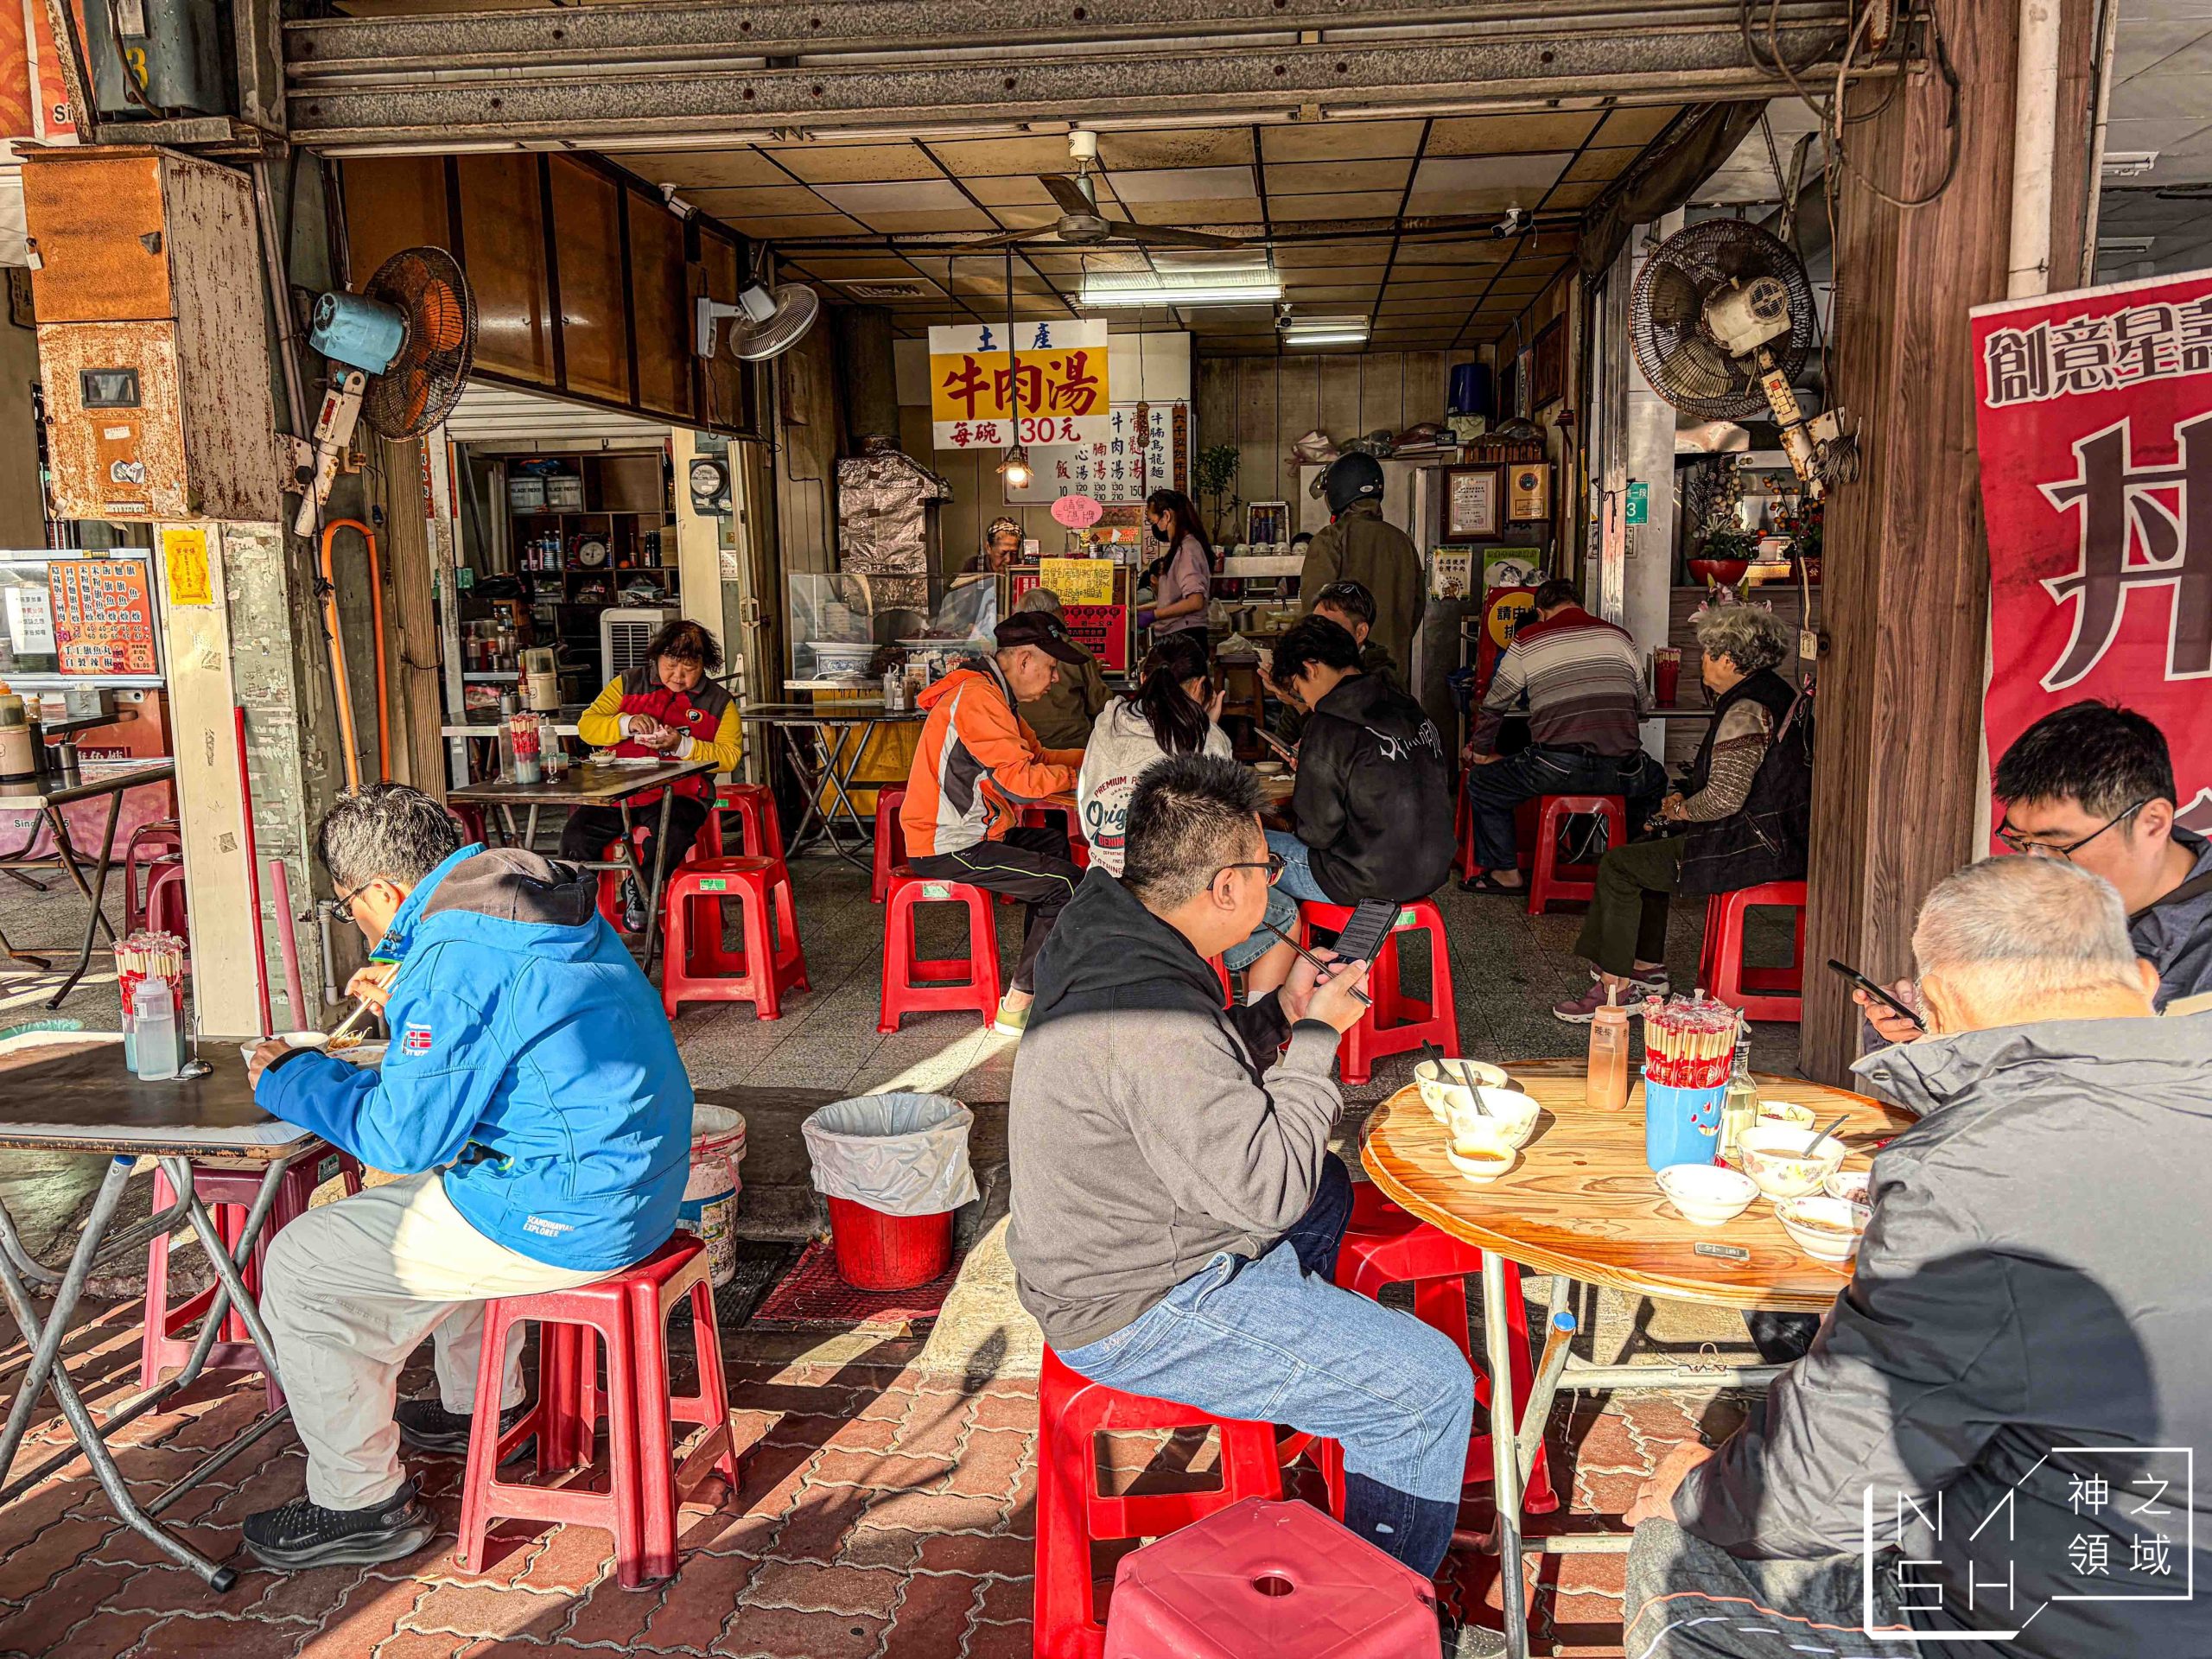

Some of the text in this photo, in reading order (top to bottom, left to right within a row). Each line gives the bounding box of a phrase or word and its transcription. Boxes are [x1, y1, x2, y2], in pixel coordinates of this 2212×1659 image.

[54, 104, 72, 123] Si
[977, 322, 1052, 352] 土產
[942, 350, 1099, 420] 牛肉湯
[950, 416, 1082, 448] 每碗30元
[1111, 411, 1124, 480] 牛肉湯
[1149, 412, 1166, 479] 牛腩烏龍麵
[1626, 502, 1637, 517] 3
[1094, 775, 1128, 798] PREMIUM
[1086, 799, 1128, 830] Orig
[1098, 835, 1126, 847] DENIM
[522, 1222, 559, 1237] EXPLORER
[527, 1215, 575, 1231] SCANDINAVIAN
